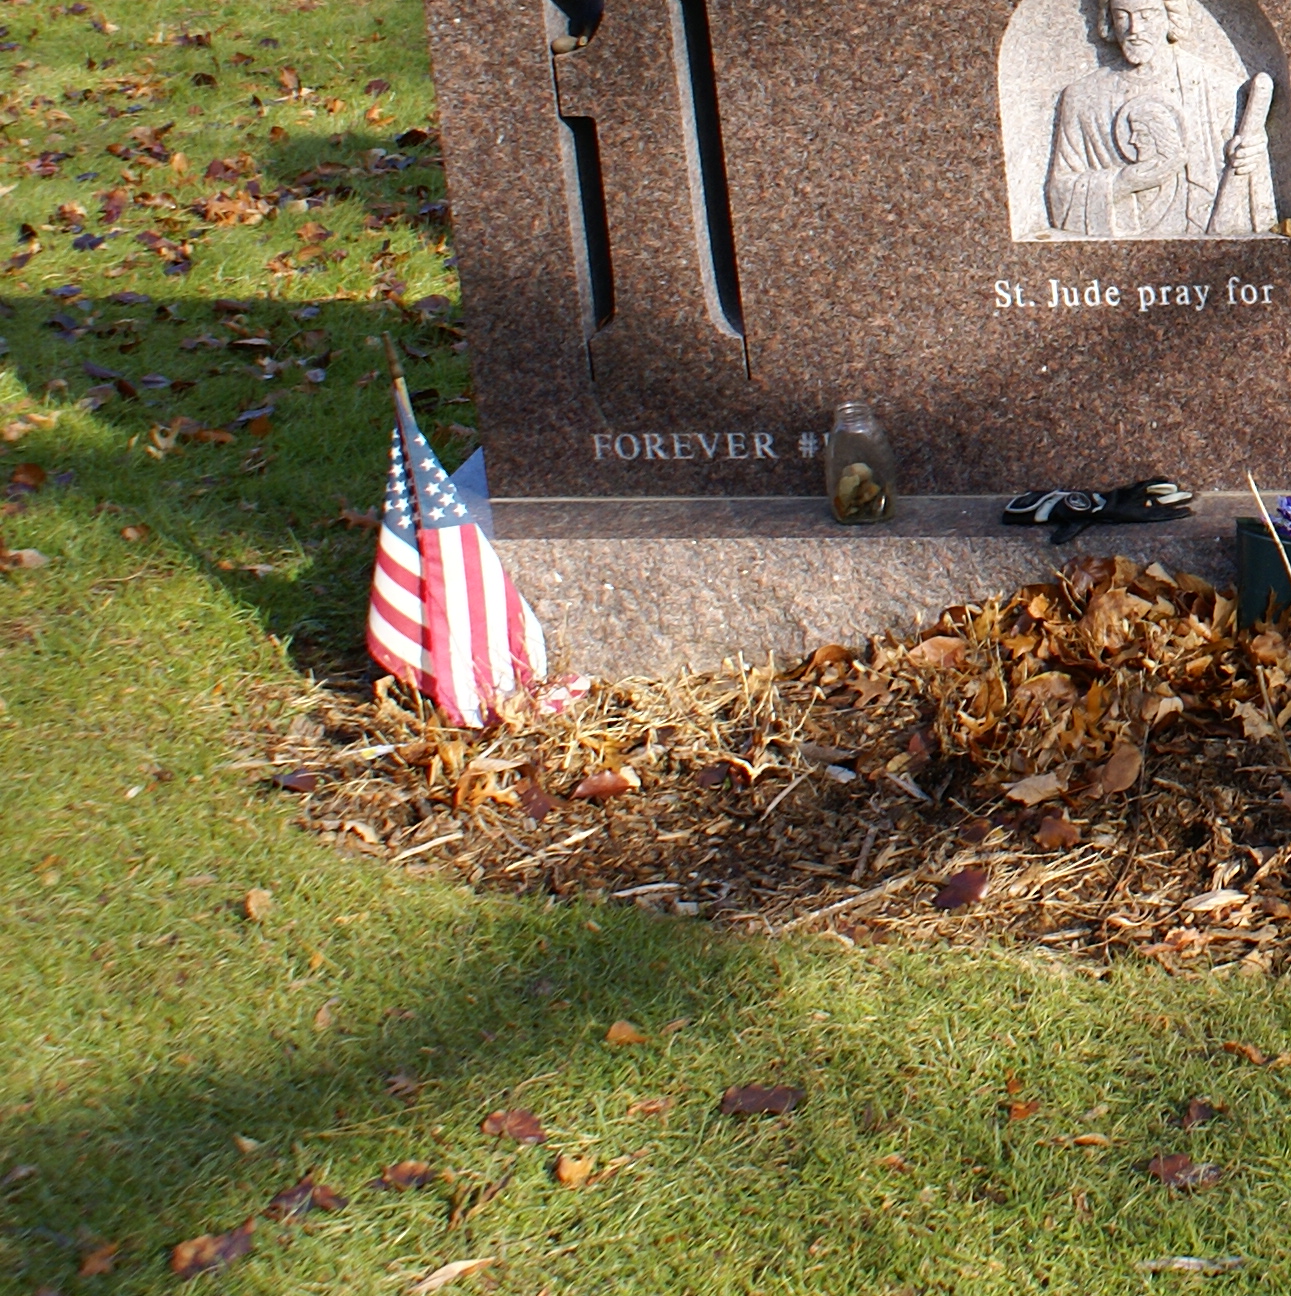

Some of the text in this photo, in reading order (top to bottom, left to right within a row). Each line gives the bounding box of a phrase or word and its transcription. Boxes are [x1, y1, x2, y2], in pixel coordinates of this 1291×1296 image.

[994, 279, 1036, 308] St.
[1047, 278, 1122, 309] Jude
[1137, 281, 1211, 312] pray
[1226, 276, 1275, 305] for
[591, 432, 780, 461] FOREVER
